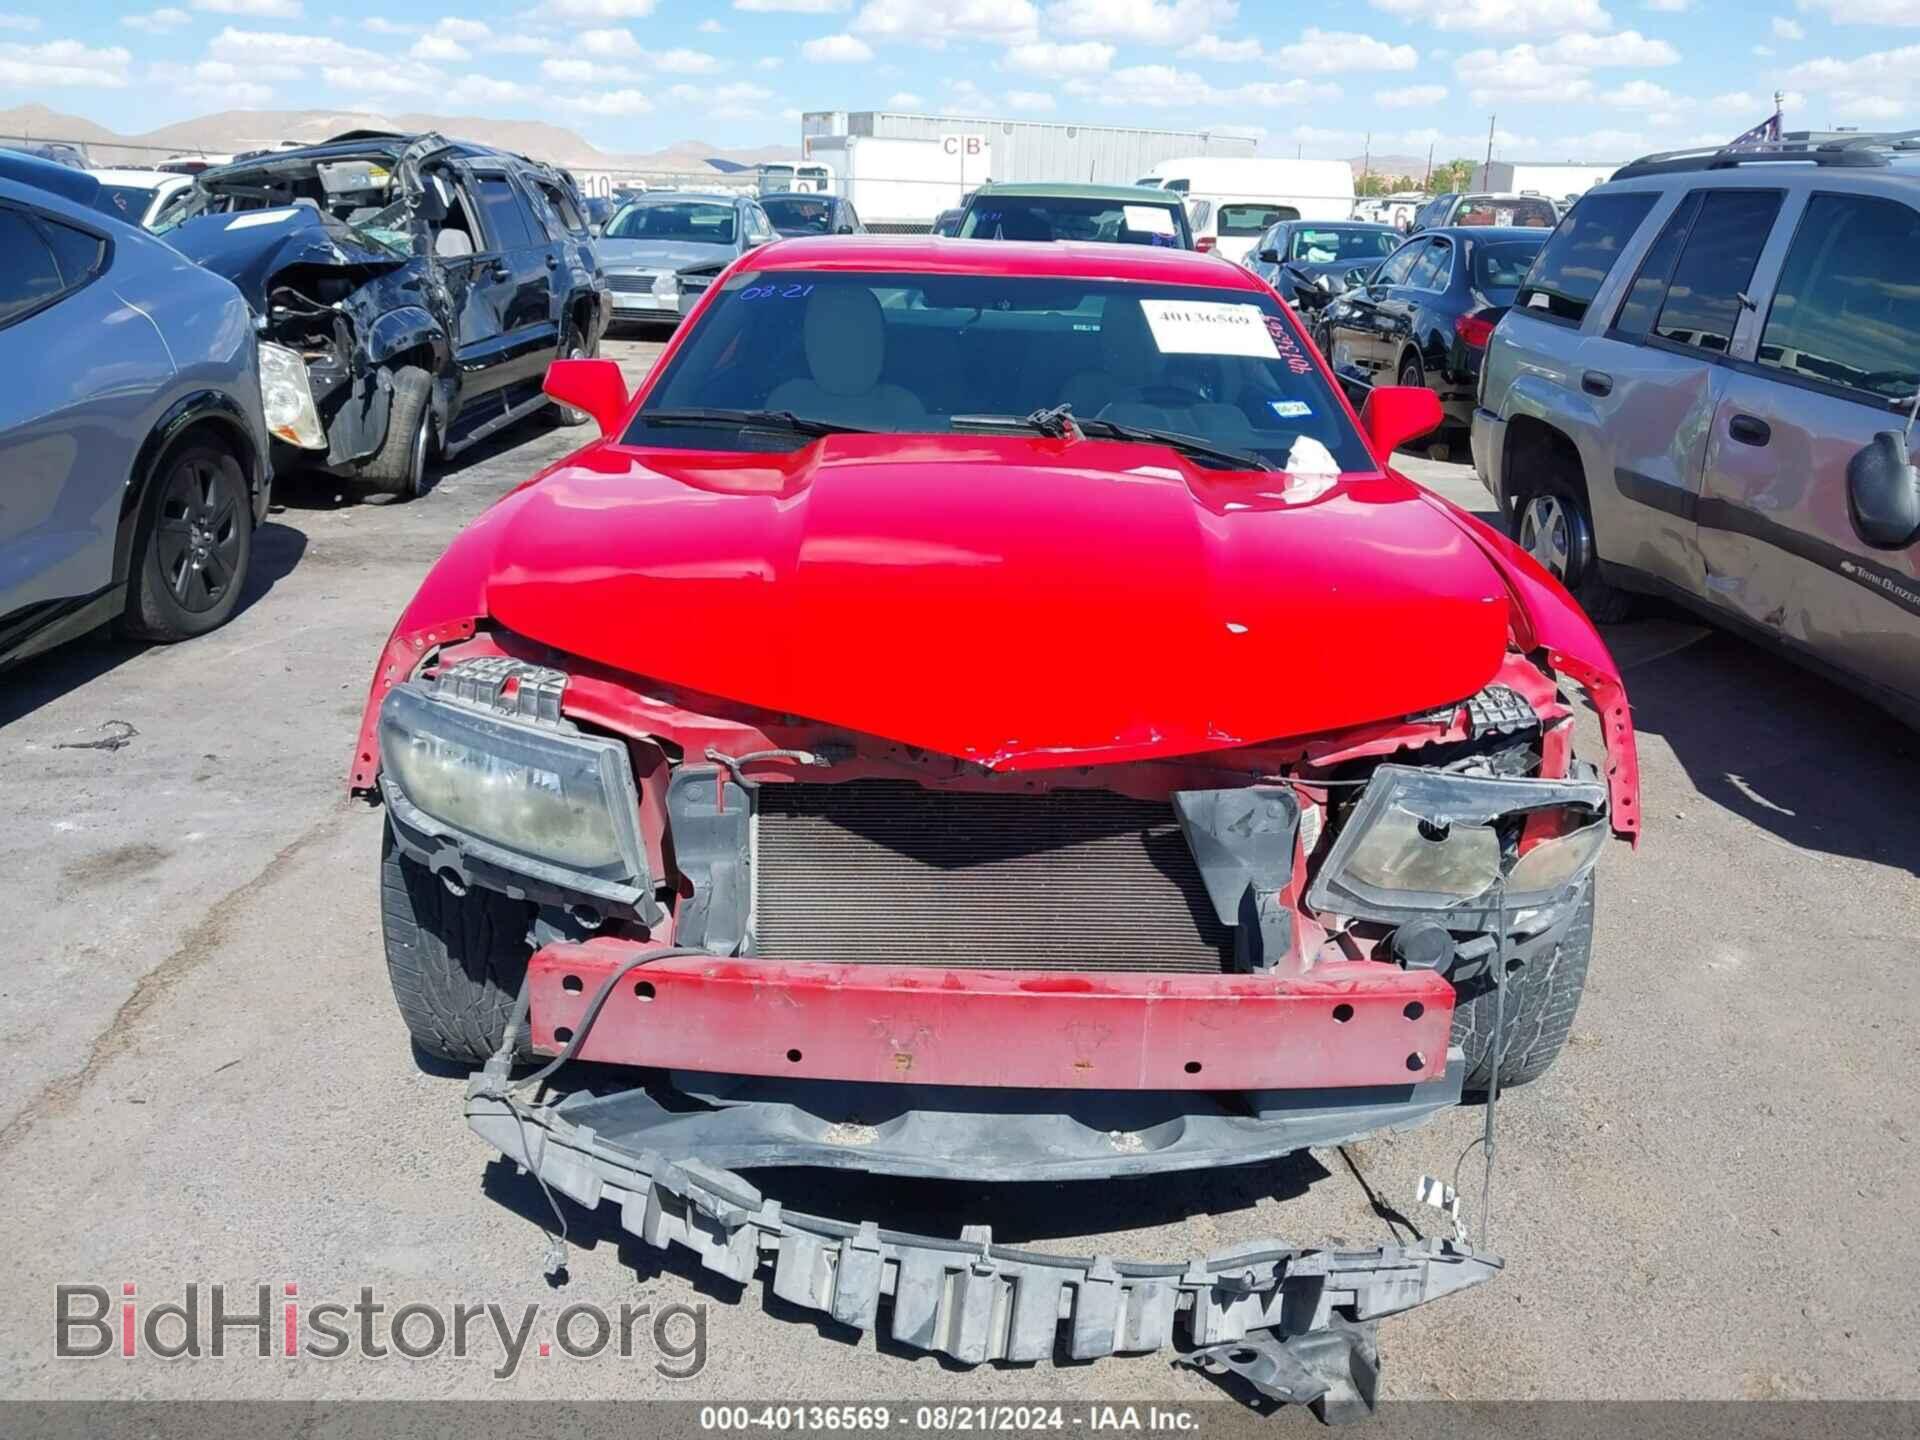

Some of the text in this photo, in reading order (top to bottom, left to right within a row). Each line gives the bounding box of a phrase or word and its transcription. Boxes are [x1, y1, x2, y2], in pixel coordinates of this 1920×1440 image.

[944, 137, 980, 154] C B
[586, 176, 609, 198] 10
[1160, 312, 1250, 324] 40136569
